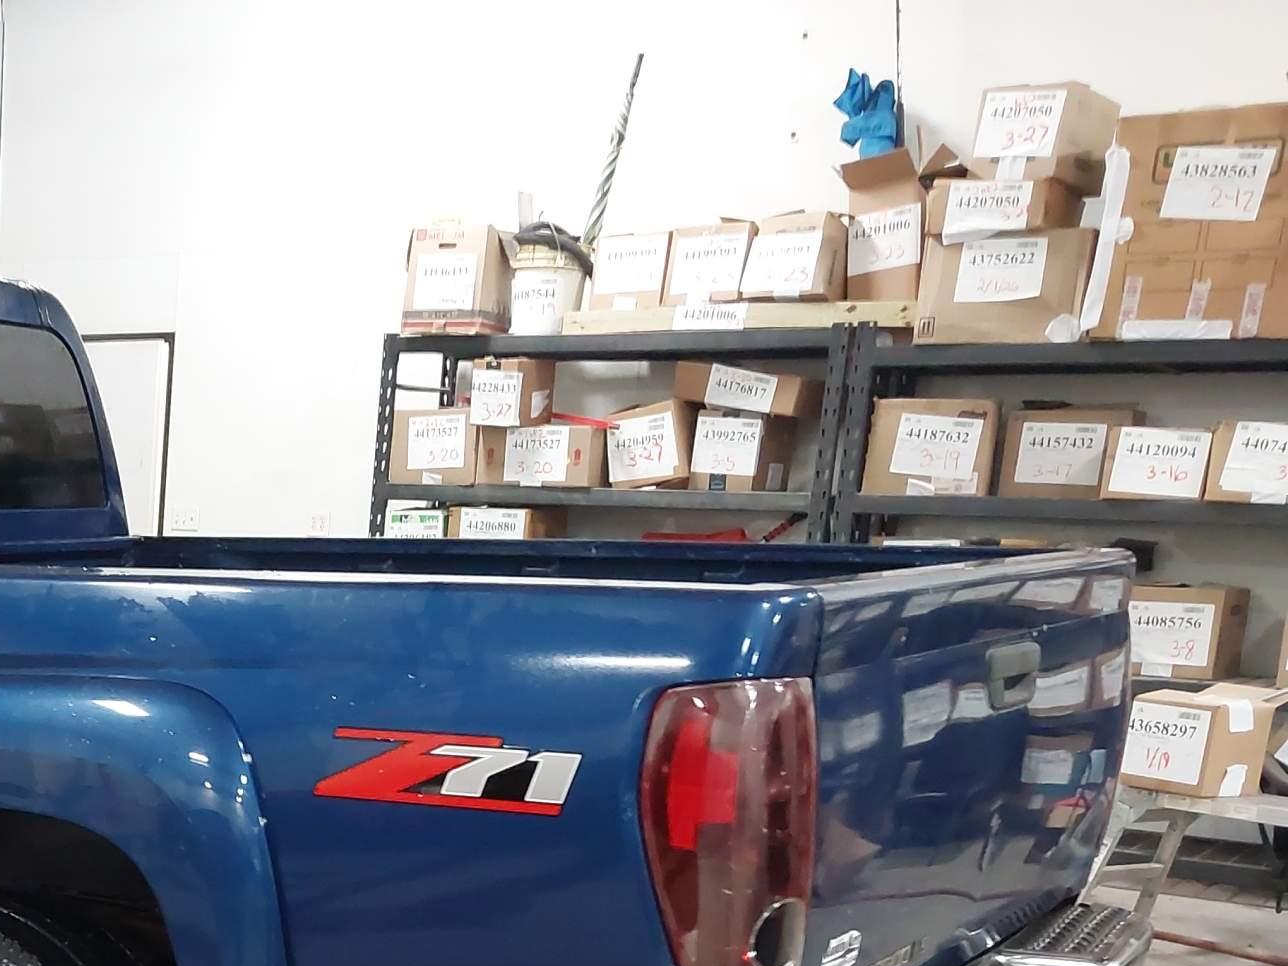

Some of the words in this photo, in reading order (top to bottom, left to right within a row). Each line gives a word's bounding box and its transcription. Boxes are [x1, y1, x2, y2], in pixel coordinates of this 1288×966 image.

[990, 105, 1053, 120] 44207050
[1001, 126, 1049, 150] 3-27
[1181, 163, 1258, 178] 43828563
[955, 195, 1020, 209] 44207050
[852, 220, 911, 241] 44201006
[969, 252, 1035, 267] 43752622
[682, 308, 737, 321] 44201006
[715, 377, 767, 399] 44176817
[414, 426, 459, 440] 44173527
[702, 429, 756, 442] 43992765
[905, 427, 969, 444] 44187632
[512, 439, 561, 450] 44173527
[1028, 436, 1094, 449] 44157432
[1126, 442, 1198, 459] 44120094
[920, 447, 961, 472] 3-19
[1146, 464, 1188, 483] 3-16
[466, 520, 516, 532] 44206880
[1133, 614, 1202, 630] 44085756
[1170, 639, 1196, 661] 3-8
[1128, 717, 1198, 740] 43658297
[313, 726, 582, 817] Z71
